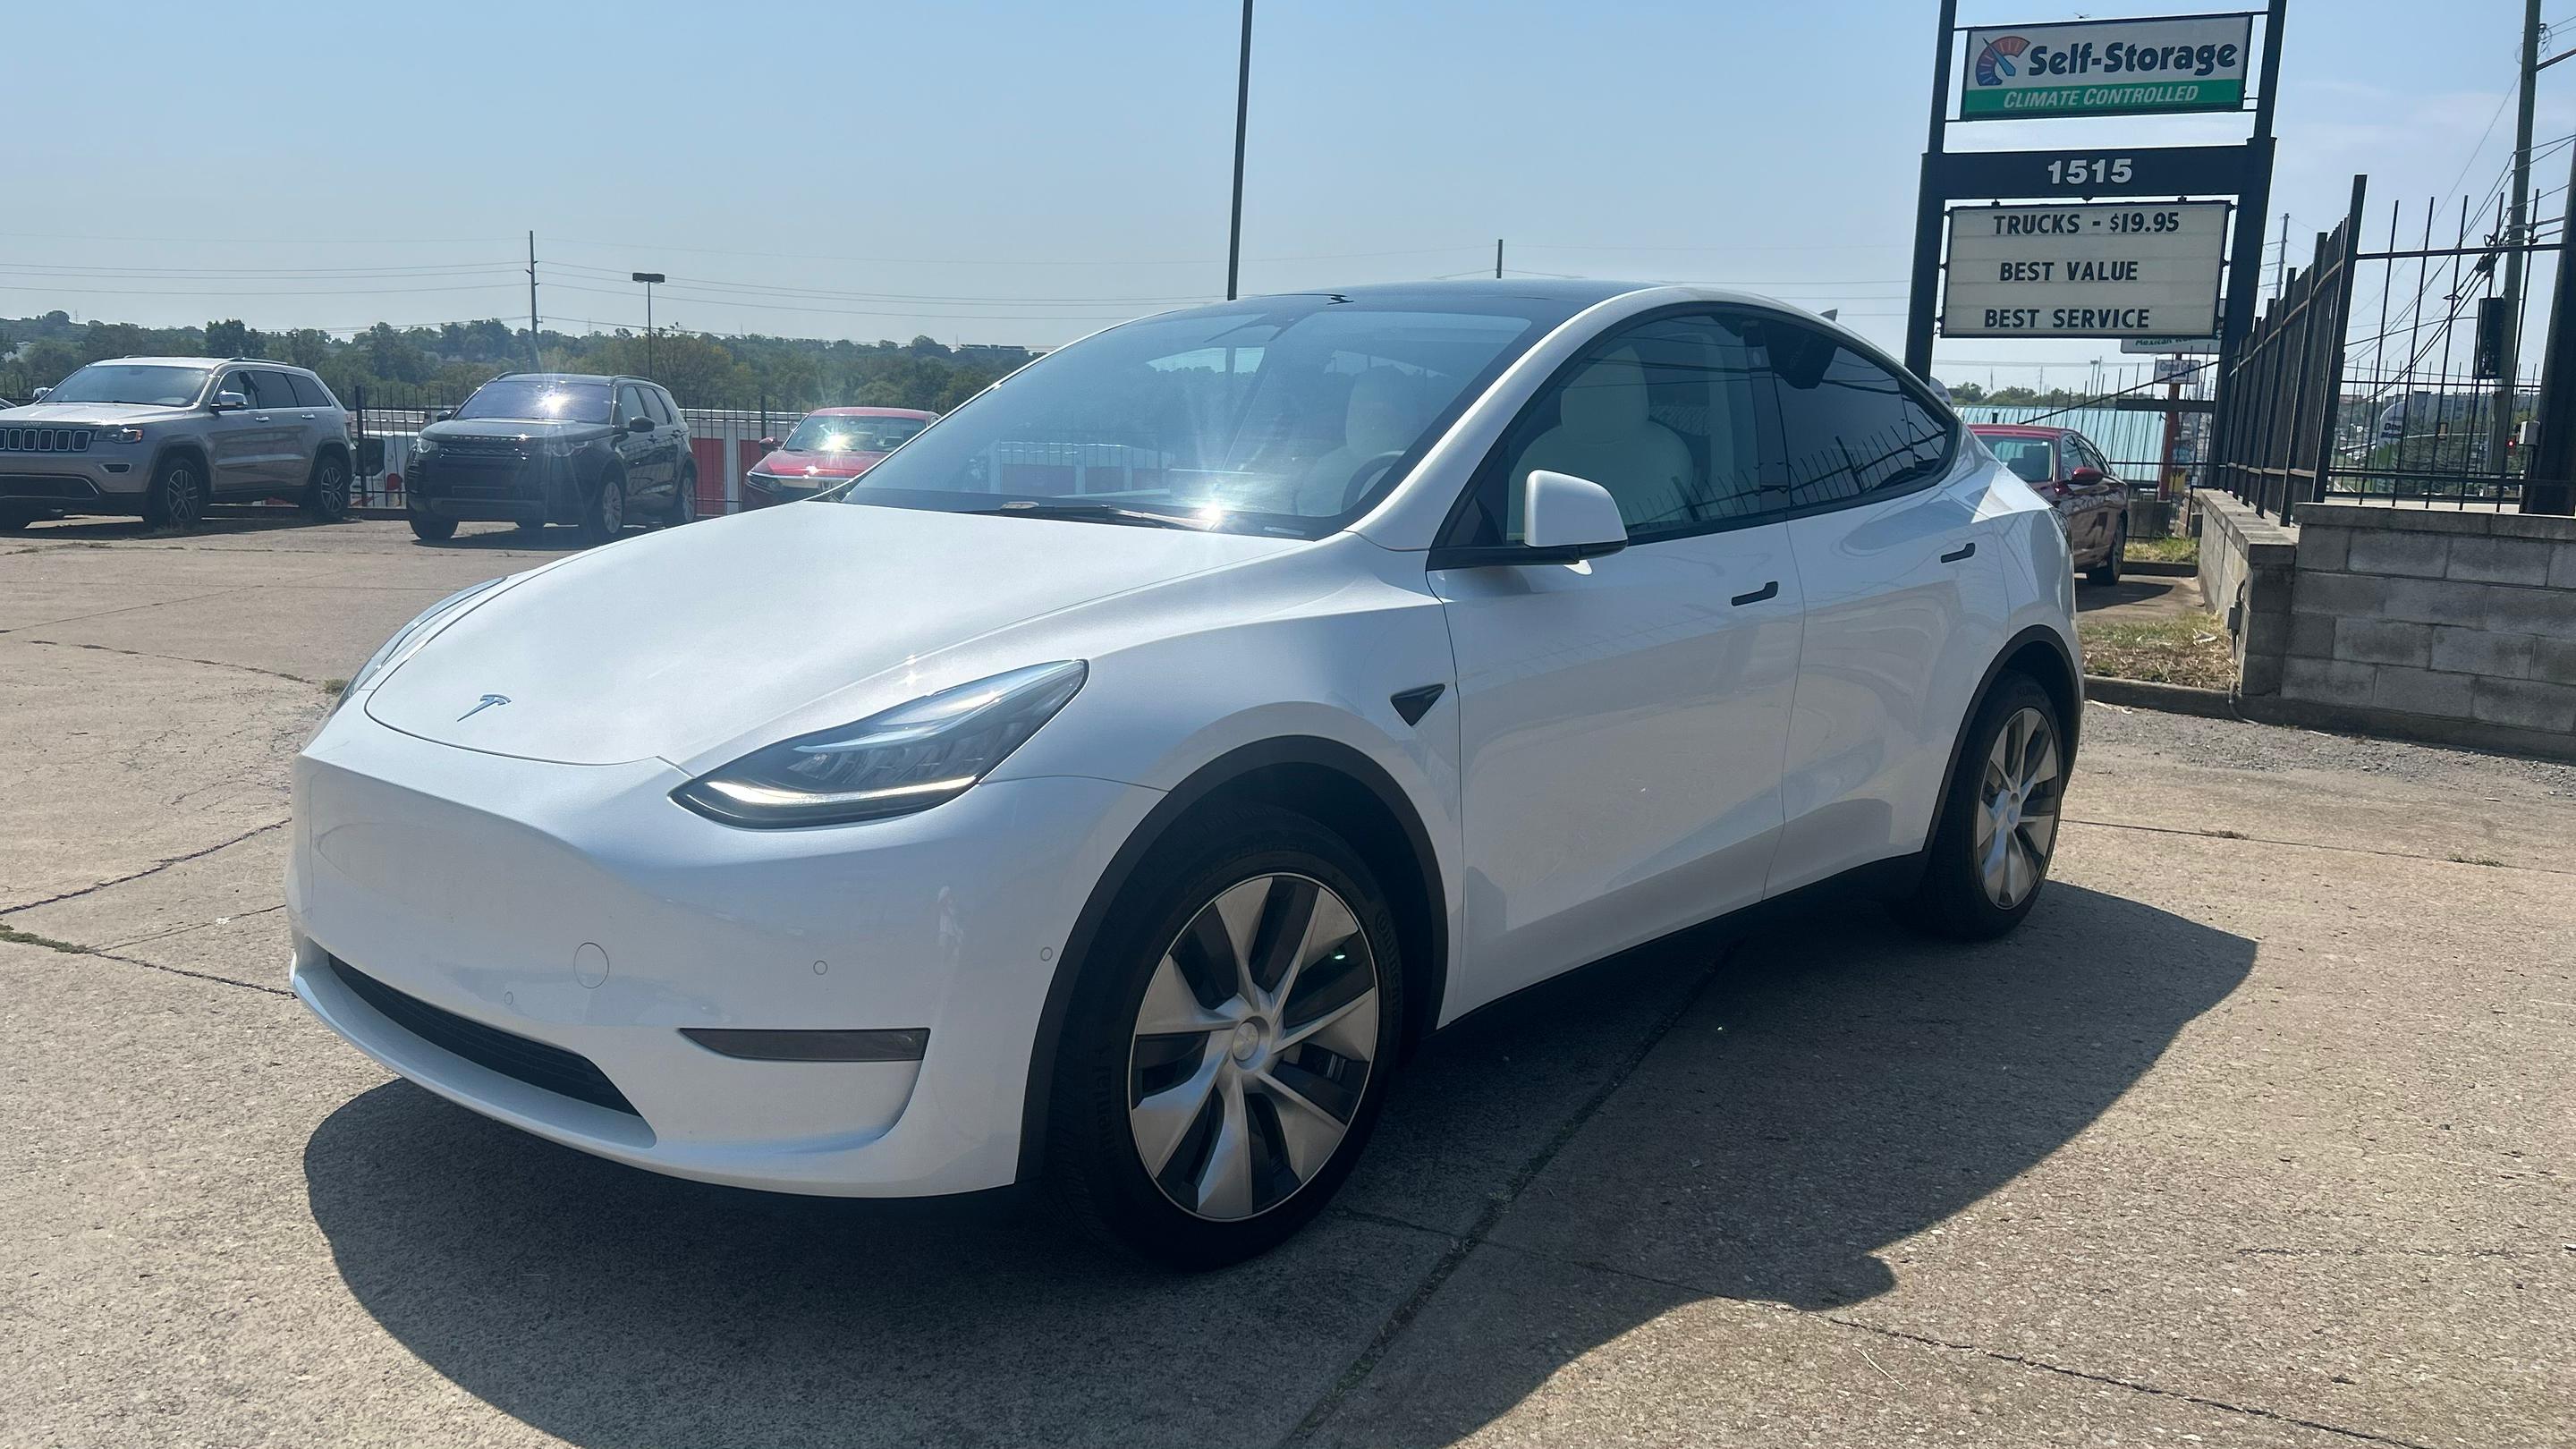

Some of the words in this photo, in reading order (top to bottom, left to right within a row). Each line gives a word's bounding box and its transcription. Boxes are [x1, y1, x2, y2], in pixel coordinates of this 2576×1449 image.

[2029, 42, 2237, 76] Self-Storage
[2004, 89, 2080, 109] CLIMATE
[2083, 86, 2199, 105] CONTROLLED
[2047, 158, 2132, 184] 1515
[1993, 214, 2080, 234] TRUCKS
[2109, 212, 2180, 233] $19.95
[1999, 262, 2055, 281] BEST
[2066, 261, 2139, 281] VALUE
[1984, 309, 2039, 328] BEST
[2053, 309, 2149, 328] SERVICE
